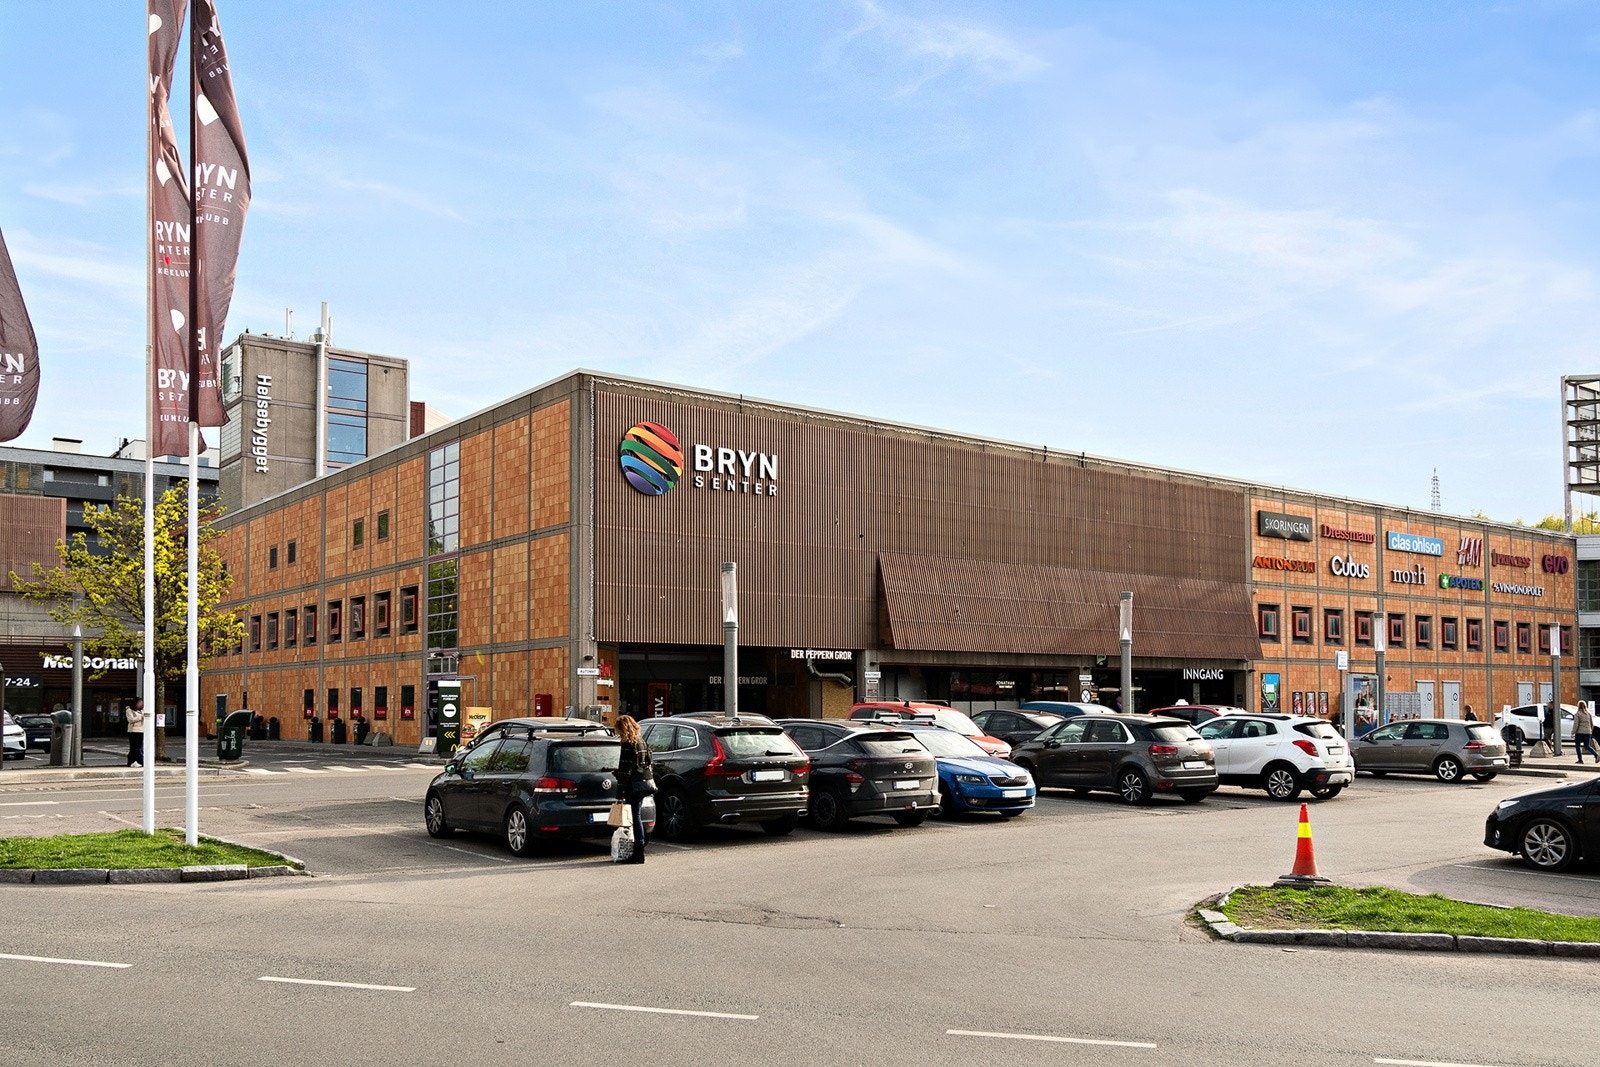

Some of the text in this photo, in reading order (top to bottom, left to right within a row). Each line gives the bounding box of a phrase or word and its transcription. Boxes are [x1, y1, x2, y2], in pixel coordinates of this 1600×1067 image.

[252, 374, 272, 474] Helsebygget
[694, 443, 778, 481] BRYN
[694, 475, 778, 497] SENTER
[1264, 518, 1309, 534] SKORINGEN
[1322, 523, 1376, 543] Dressmann
[1390, 533, 1441, 554] clas ohlson
[1331, 555, 1370, 579] Cubus
[1391, 564, 1427, 585] norli
[1544, 554, 1569, 574] evo
[790, 649, 852, 660] DER PEPPERN GROR
[1183, 668, 1224, 680] INNGANG
